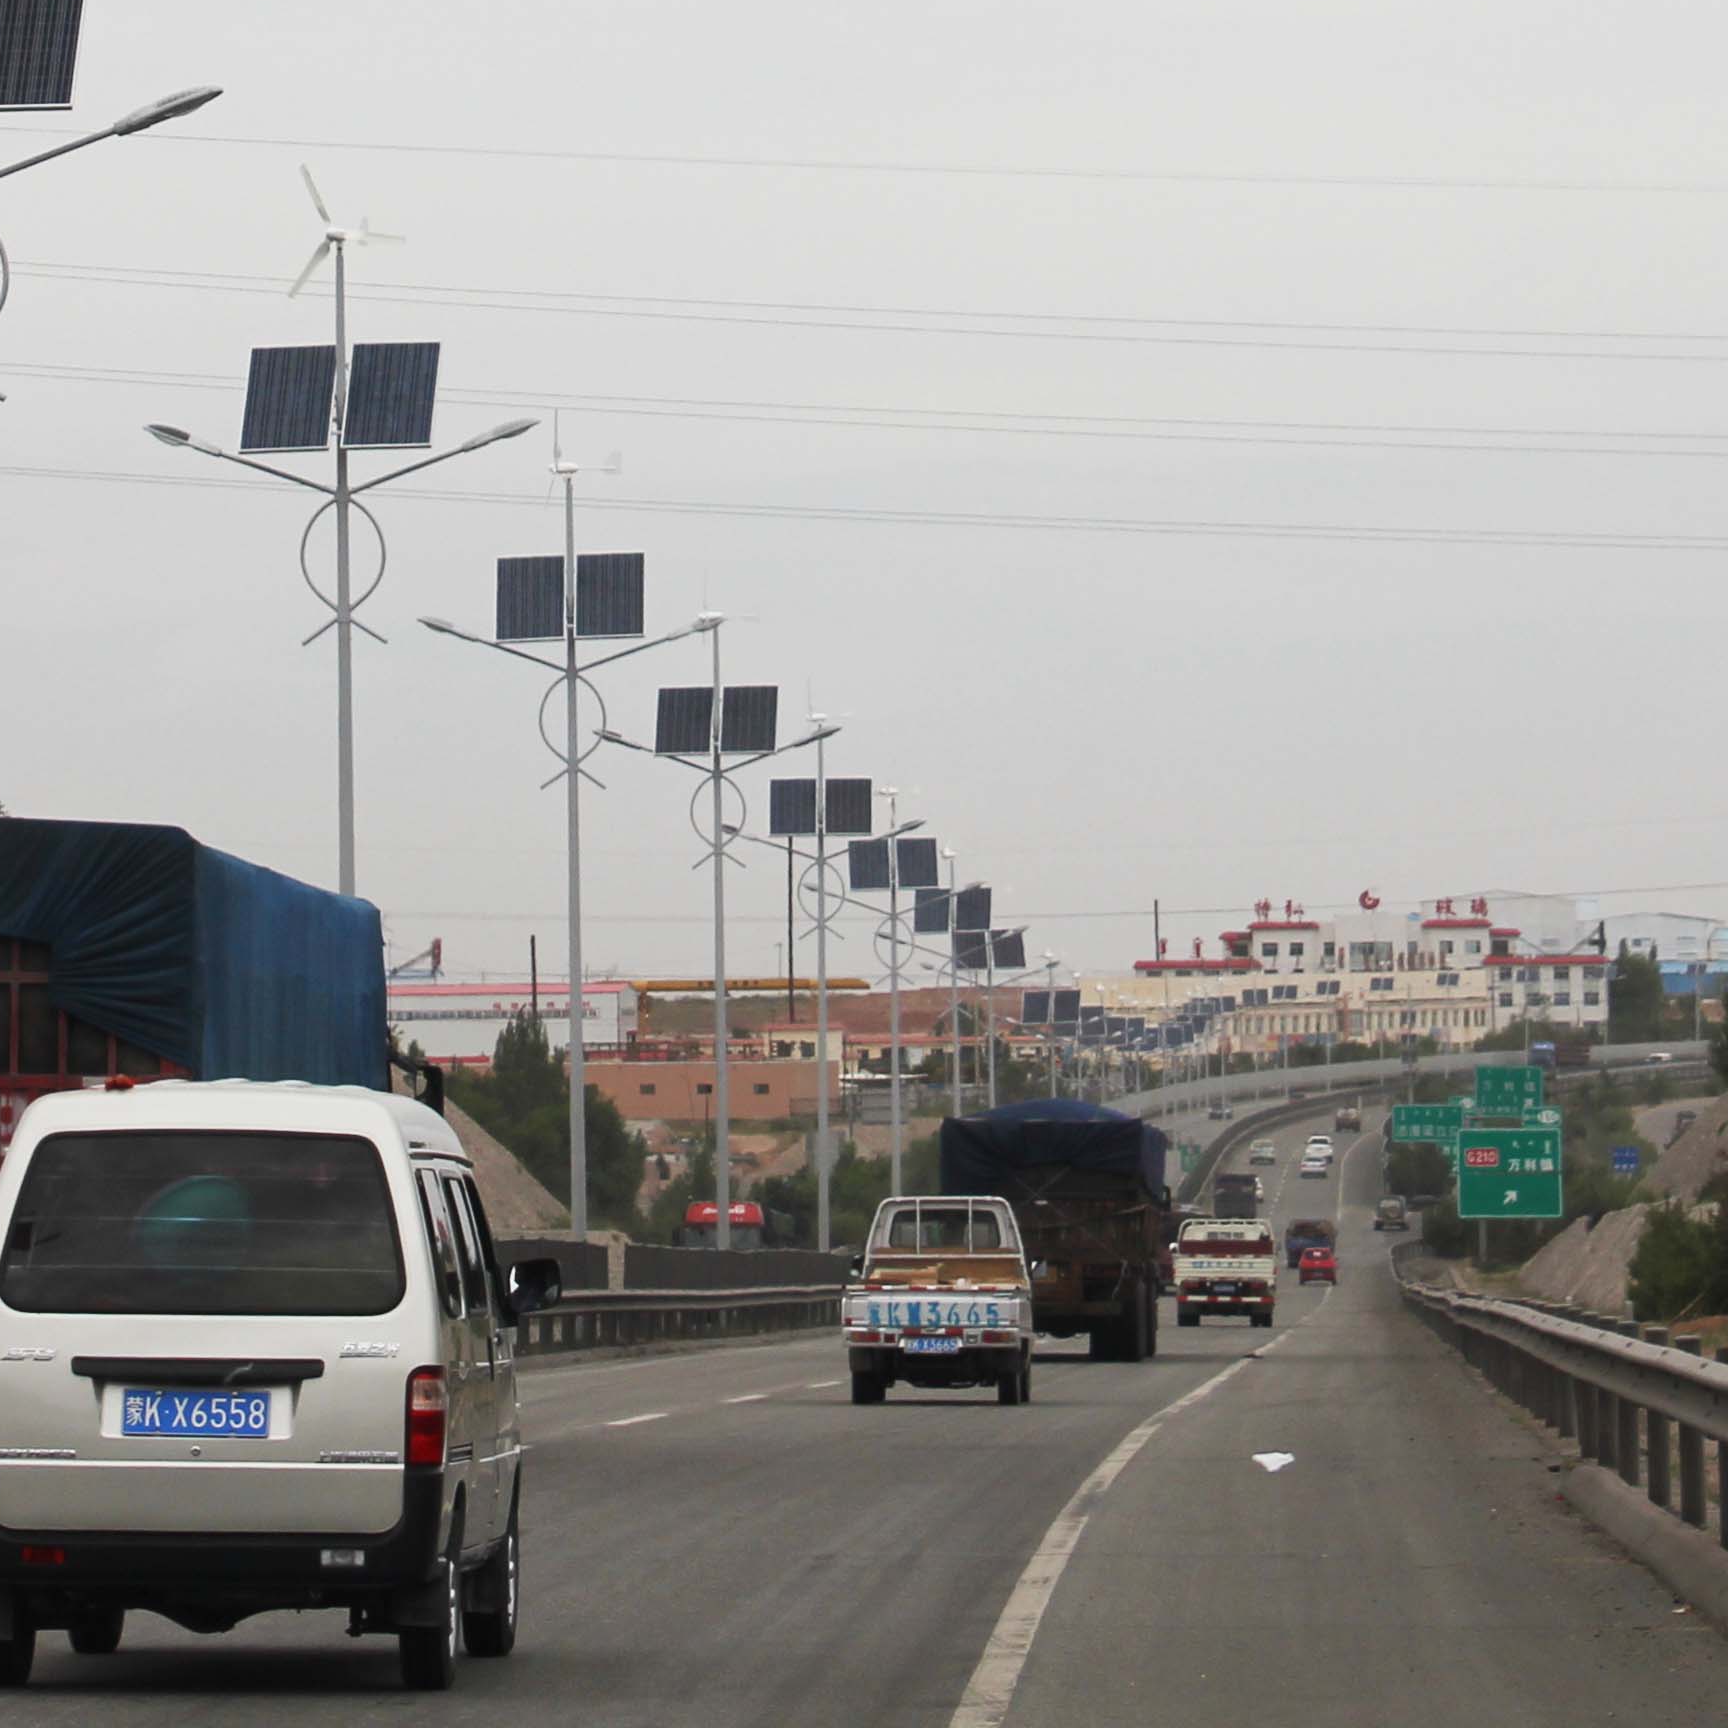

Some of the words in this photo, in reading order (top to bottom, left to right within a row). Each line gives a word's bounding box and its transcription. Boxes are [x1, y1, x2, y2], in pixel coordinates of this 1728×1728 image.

[1466, 1151, 1497, 1163] G210
[1507, 1158, 1554, 1172] 万利镇
